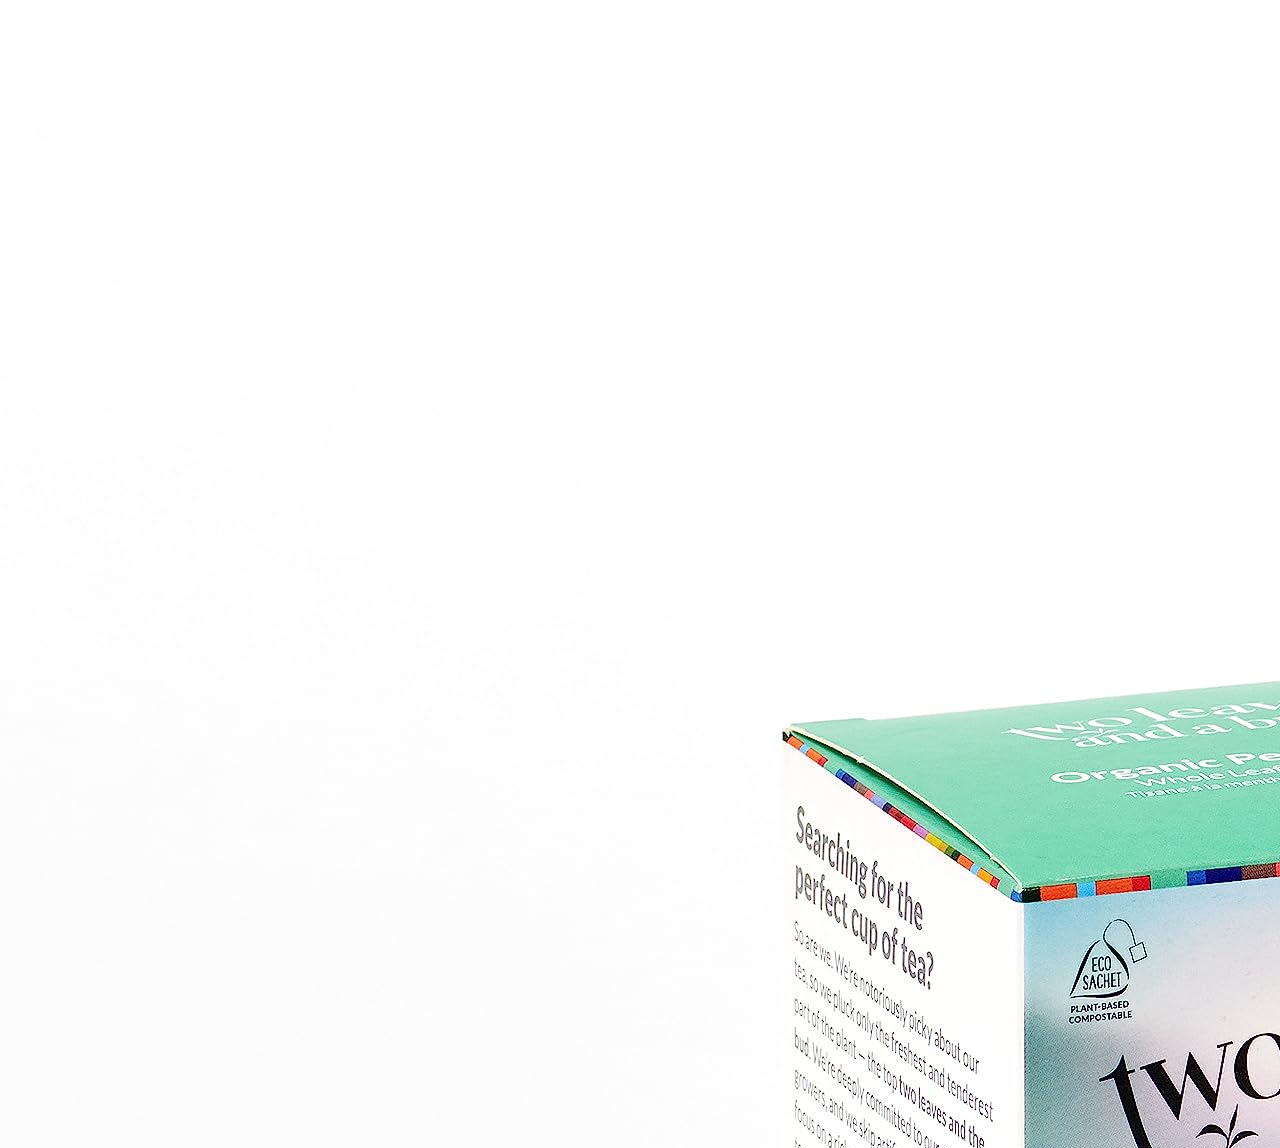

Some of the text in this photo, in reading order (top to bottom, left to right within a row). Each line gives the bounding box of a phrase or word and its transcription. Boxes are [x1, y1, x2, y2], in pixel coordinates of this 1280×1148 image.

[1000, 716, 1133, 741] two
[1071, 723, 1189, 748] and
[1191, 720, 1233, 736] a
[1050, 757, 1225, 783] Organic
[1135, 770, 1226, 788] Whole
[1124, 786, 1189, 800] Tisane
[1191, 784, 1204, 793] à
[1204, 782, 1222, 791] la
[796, 806, 923, 930] Searching for the
[795, 864, 934, 990] perfect cup of tea?
[1091, 956, 1112, 972] ECO
[1082, 972, 1122, 990] SACHET
[834, 951, 979, 1075] We're notoriously picky about our
[1068, 1010, 1133, 1024] COMPOSTABLE
[1070, 1000, 1130, 1013] PLANT-BASED
[834, 990, 993, 1122] pluck only the freshest and tenderest
[868, 1052, 881, 1079] the
[883, 1063, 897, 1093] top
[899, 1075, 916, 1104] two
[918, 1086, 946, 1131] leaves
[949, 1116, 966, 1141] and
[866, 1092, 911, 1138] committed
[913, 1123, 922, 1146] to
